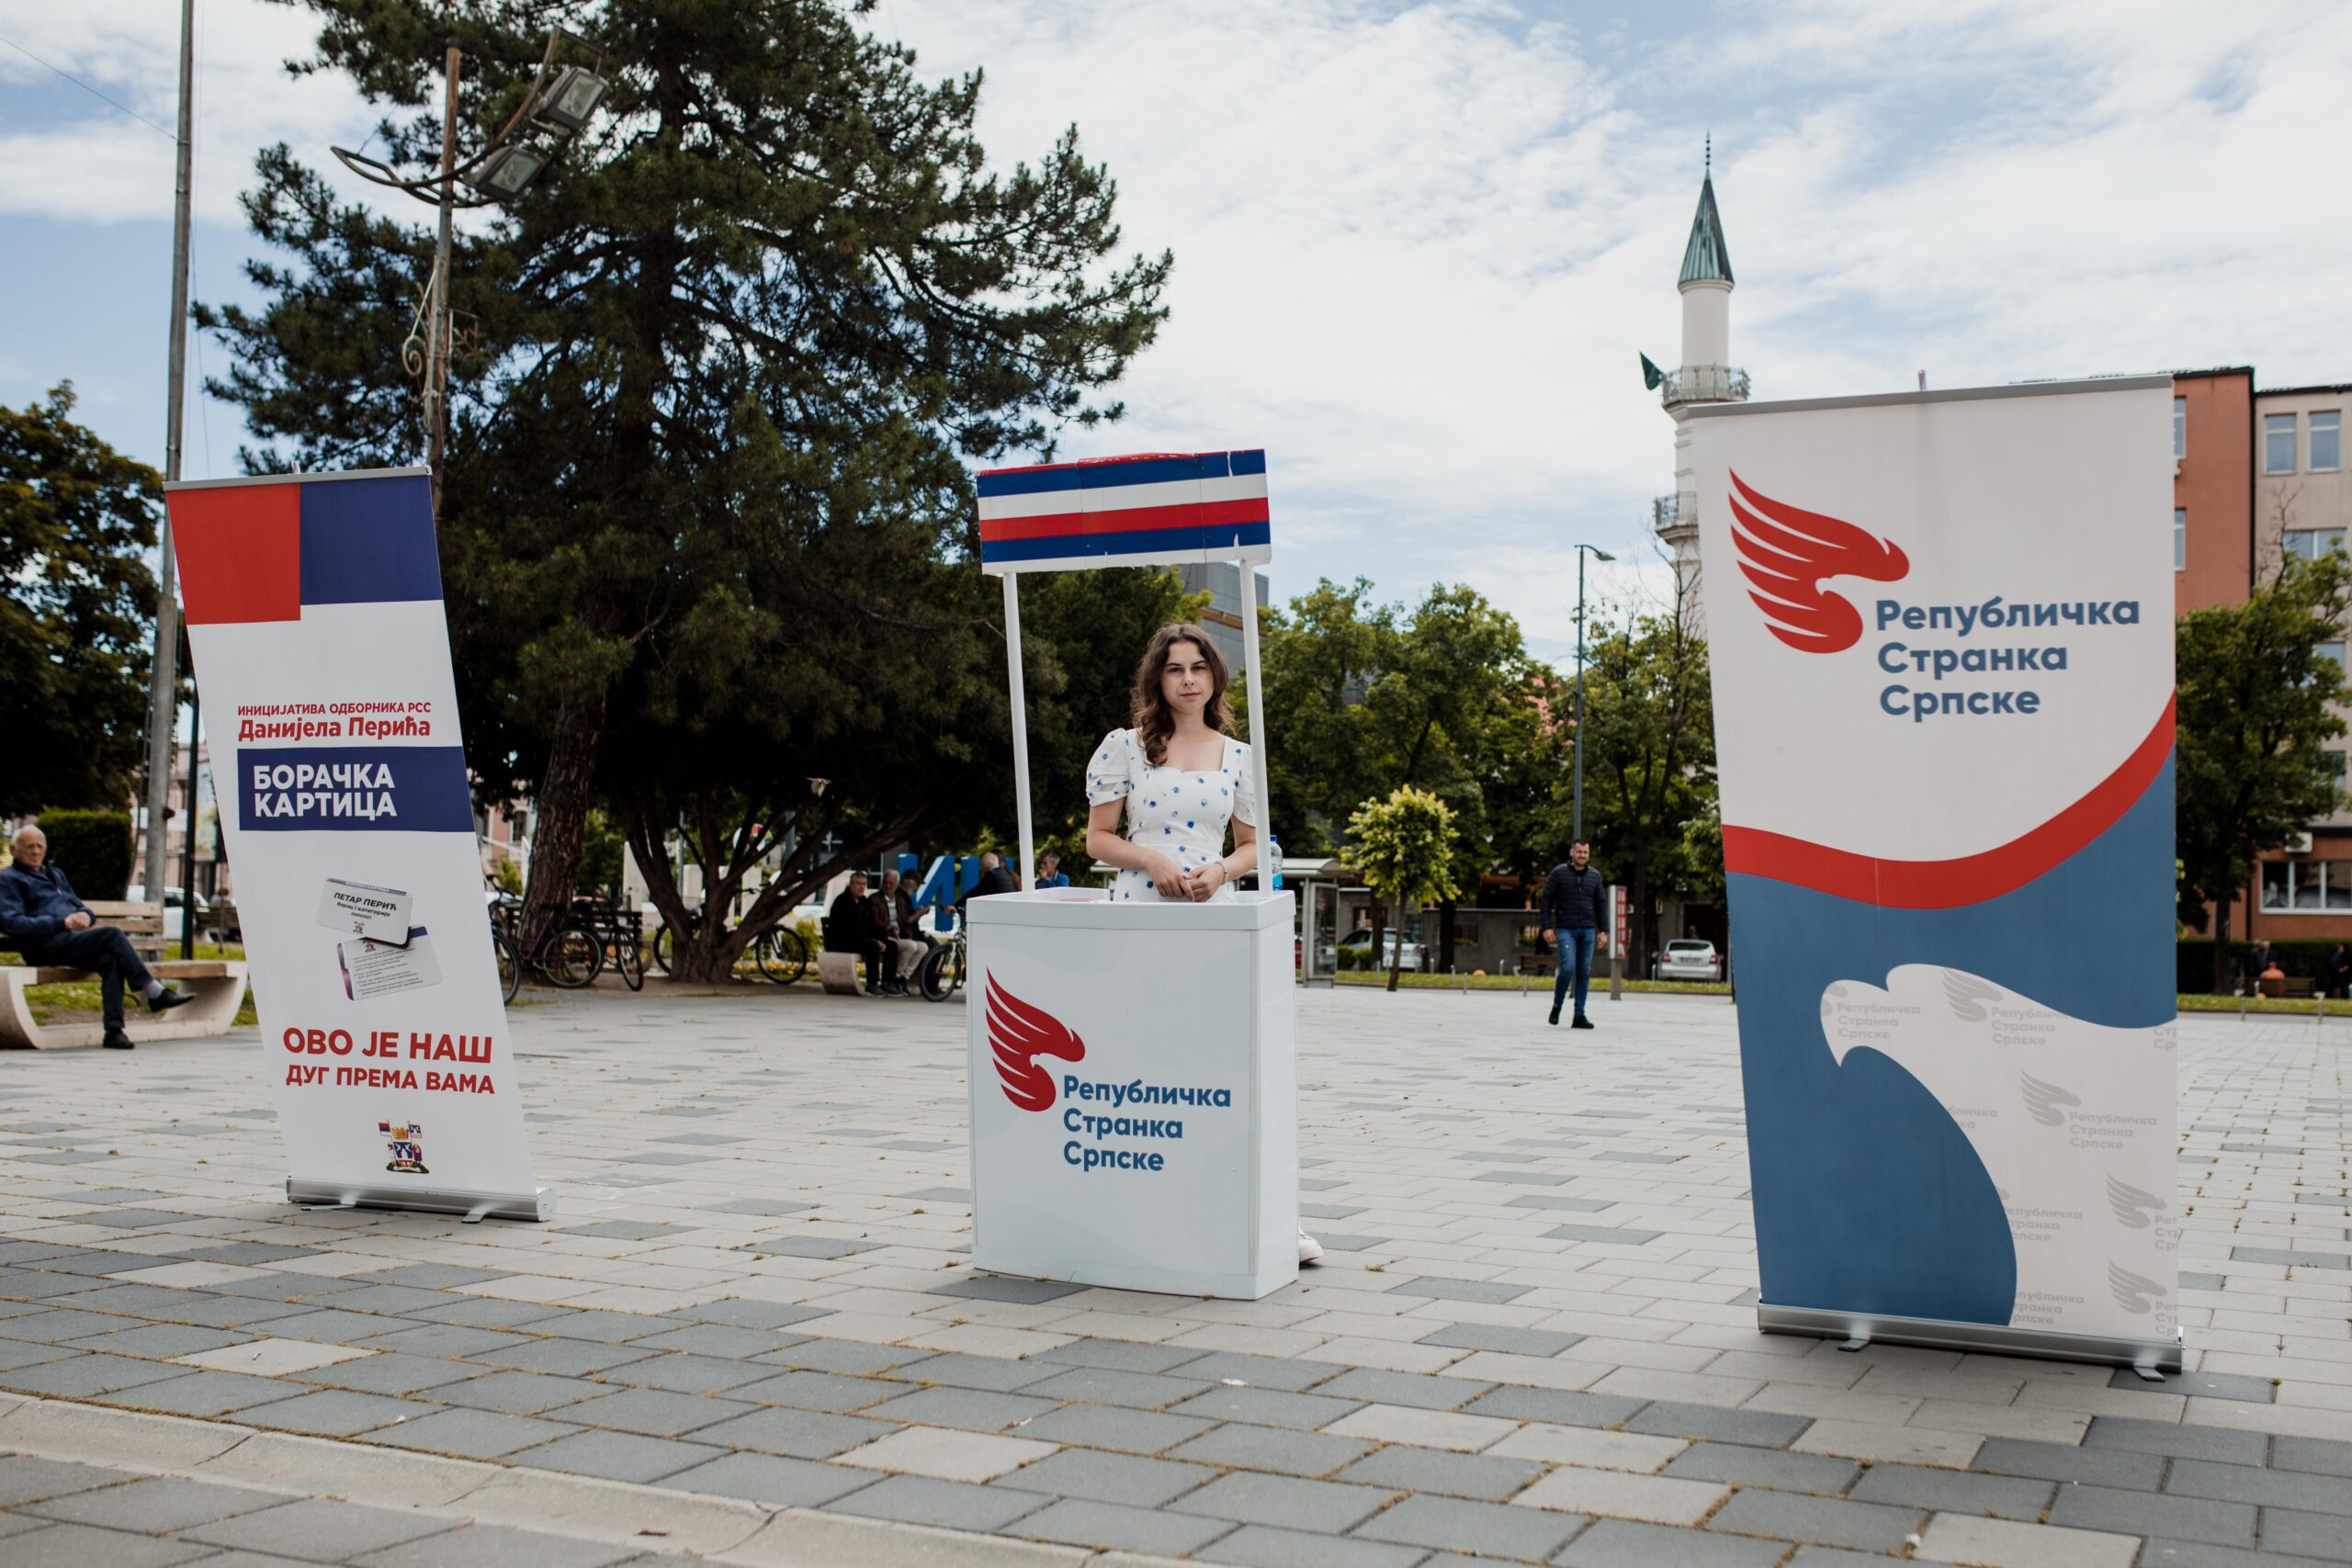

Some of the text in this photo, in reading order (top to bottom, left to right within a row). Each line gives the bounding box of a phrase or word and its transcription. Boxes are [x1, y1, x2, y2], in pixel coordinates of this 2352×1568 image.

[1876, 595, 2140, 637] Републичка
[1878, 641, 2067, 681] Странка
[237, 702, 432, 717] ИНИЦИЈАТИВА ОДБОРНИКА РСС
[1880, 683, 2041, 723] Српске
[238, 716, 431, 741] Данијела Перића
[254, 763, 395, 790] БОРАЧКА
[254, 792, 398, 821] КАРТИЦА
[334, 892, 362, 904] ПЕТАР
[1838, 1001, 1921, 1015] Републичка
[1838, 1015, 1899, 1028] Странка
[1992, 1020, 2055, 1033] Странка
[283, 1027, 492, 1064] ОВО ЈЕ НАШ
[1838, 1028, 1891, 1041] Српске
[1992, 1033, 2047, 1046] Српске
[286, 1065, 495, 1095] ДУГ ПРЕМА ВАМА
[1063, 1075, 1231, 1108] Републичка
[1063, 1108, 1183, 1140] Странка
[2069, 1111, 2157, 1125] Републичка
[2069, 1123, 2133, 1137] Странка
[1063, 1140, 1164, 1172] Српске
[2070, 1137, 2124, 1150] Српске
